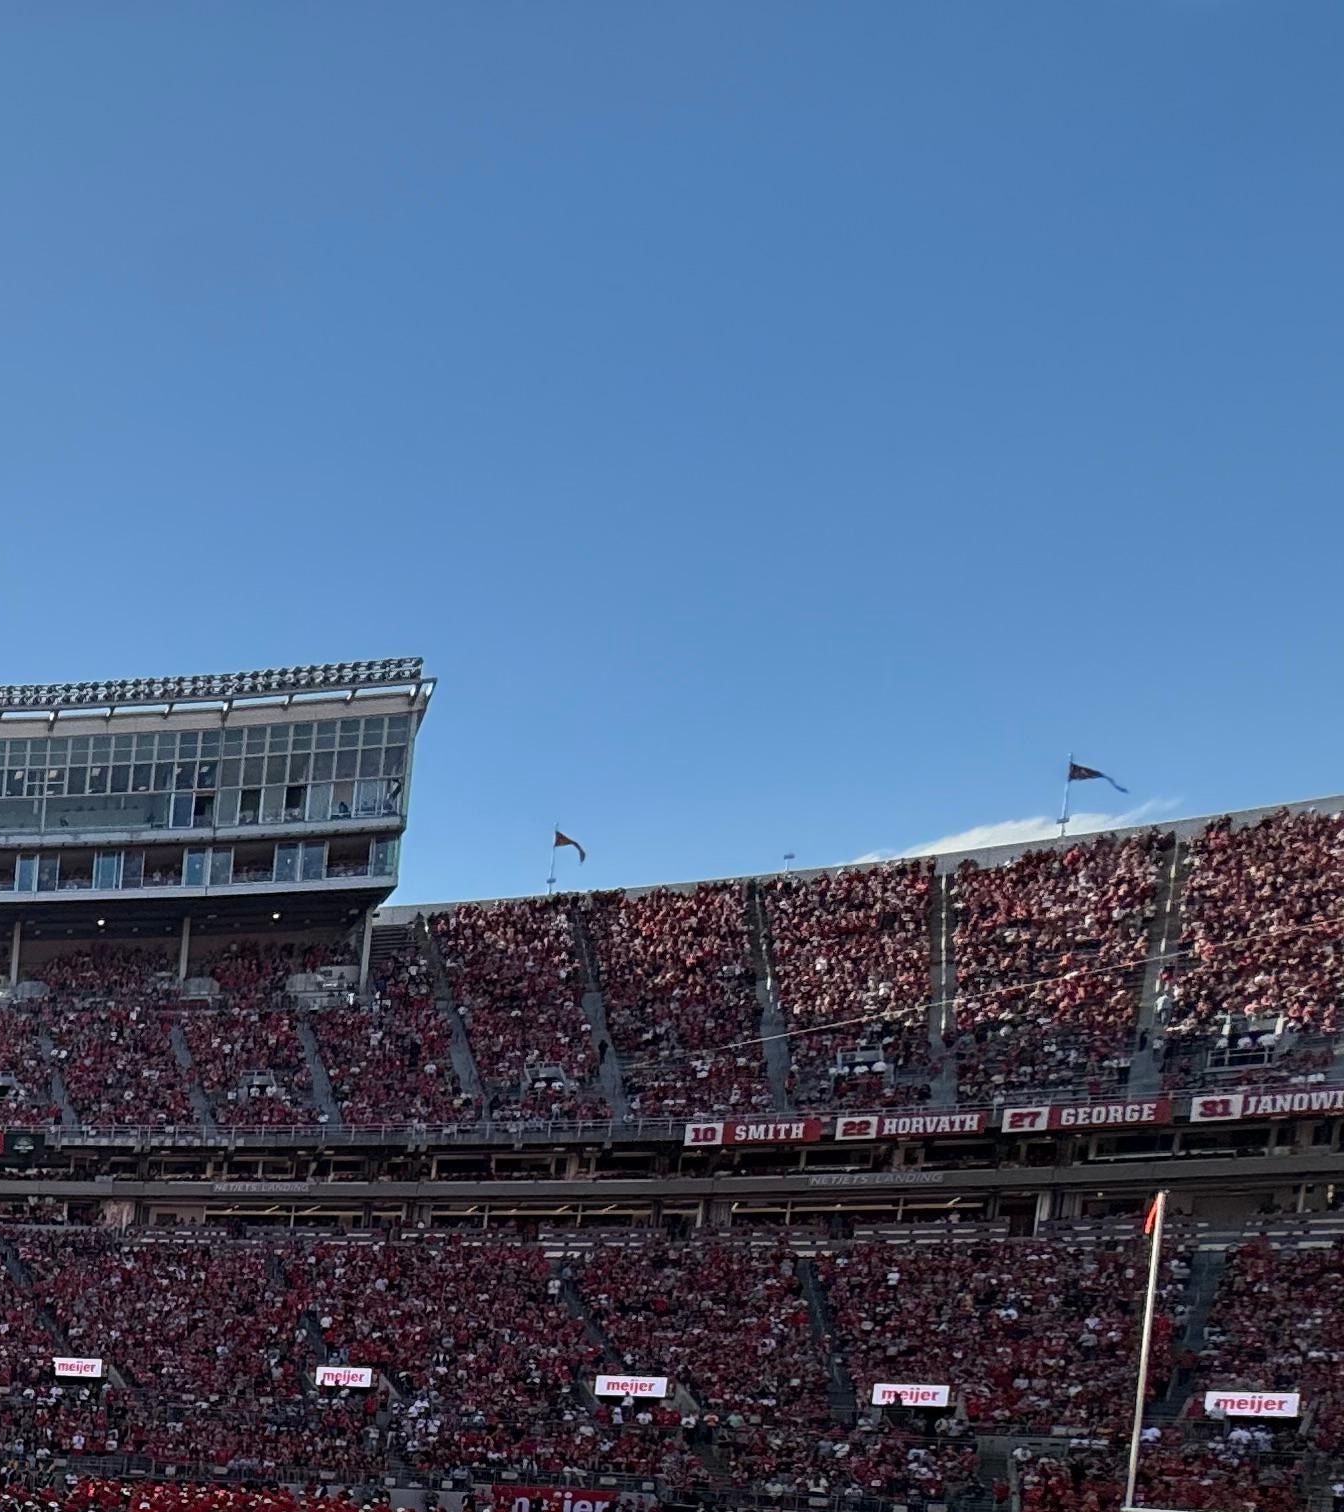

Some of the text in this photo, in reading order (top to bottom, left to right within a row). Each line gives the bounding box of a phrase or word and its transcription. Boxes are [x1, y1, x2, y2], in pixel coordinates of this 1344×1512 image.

[881, 1114, 981, 1136] HORVATH
[1008, 1103, 1157, 1130] 27 GEORGE
[733, 1122, 806, 1142] SMITH
[875, 1172, 944, 1184] LANDING
[58, 1360, 97, 1376] meijer
[322, 1368, 367, 1386] meijer
[606, 1378, 656, 1395] meijer
[1214, 1393, 1289, 1415] meijer
